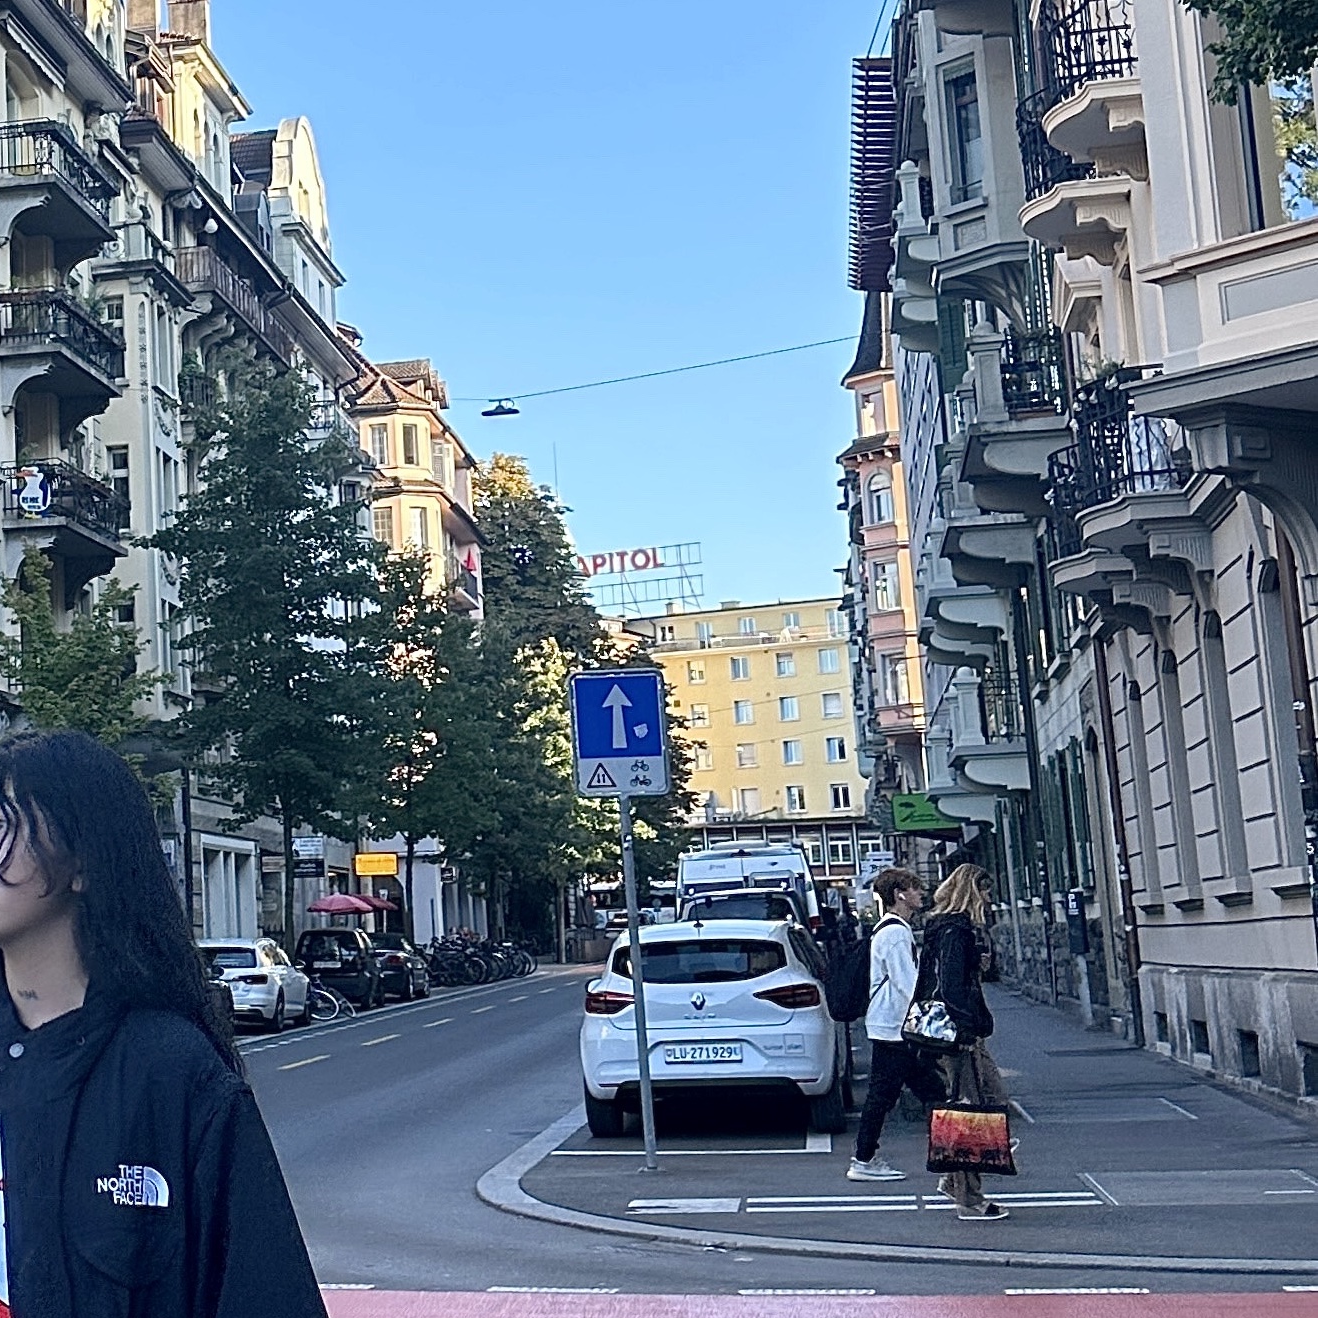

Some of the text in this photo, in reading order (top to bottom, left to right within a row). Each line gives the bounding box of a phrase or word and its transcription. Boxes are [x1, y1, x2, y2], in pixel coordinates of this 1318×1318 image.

[577, 548, 665, 578] APITOL
[118, 1164, 143, 1179] THE
[97, 1177, 142, 1194] NORTH
[113, 1190, 144, 1206] FACE
